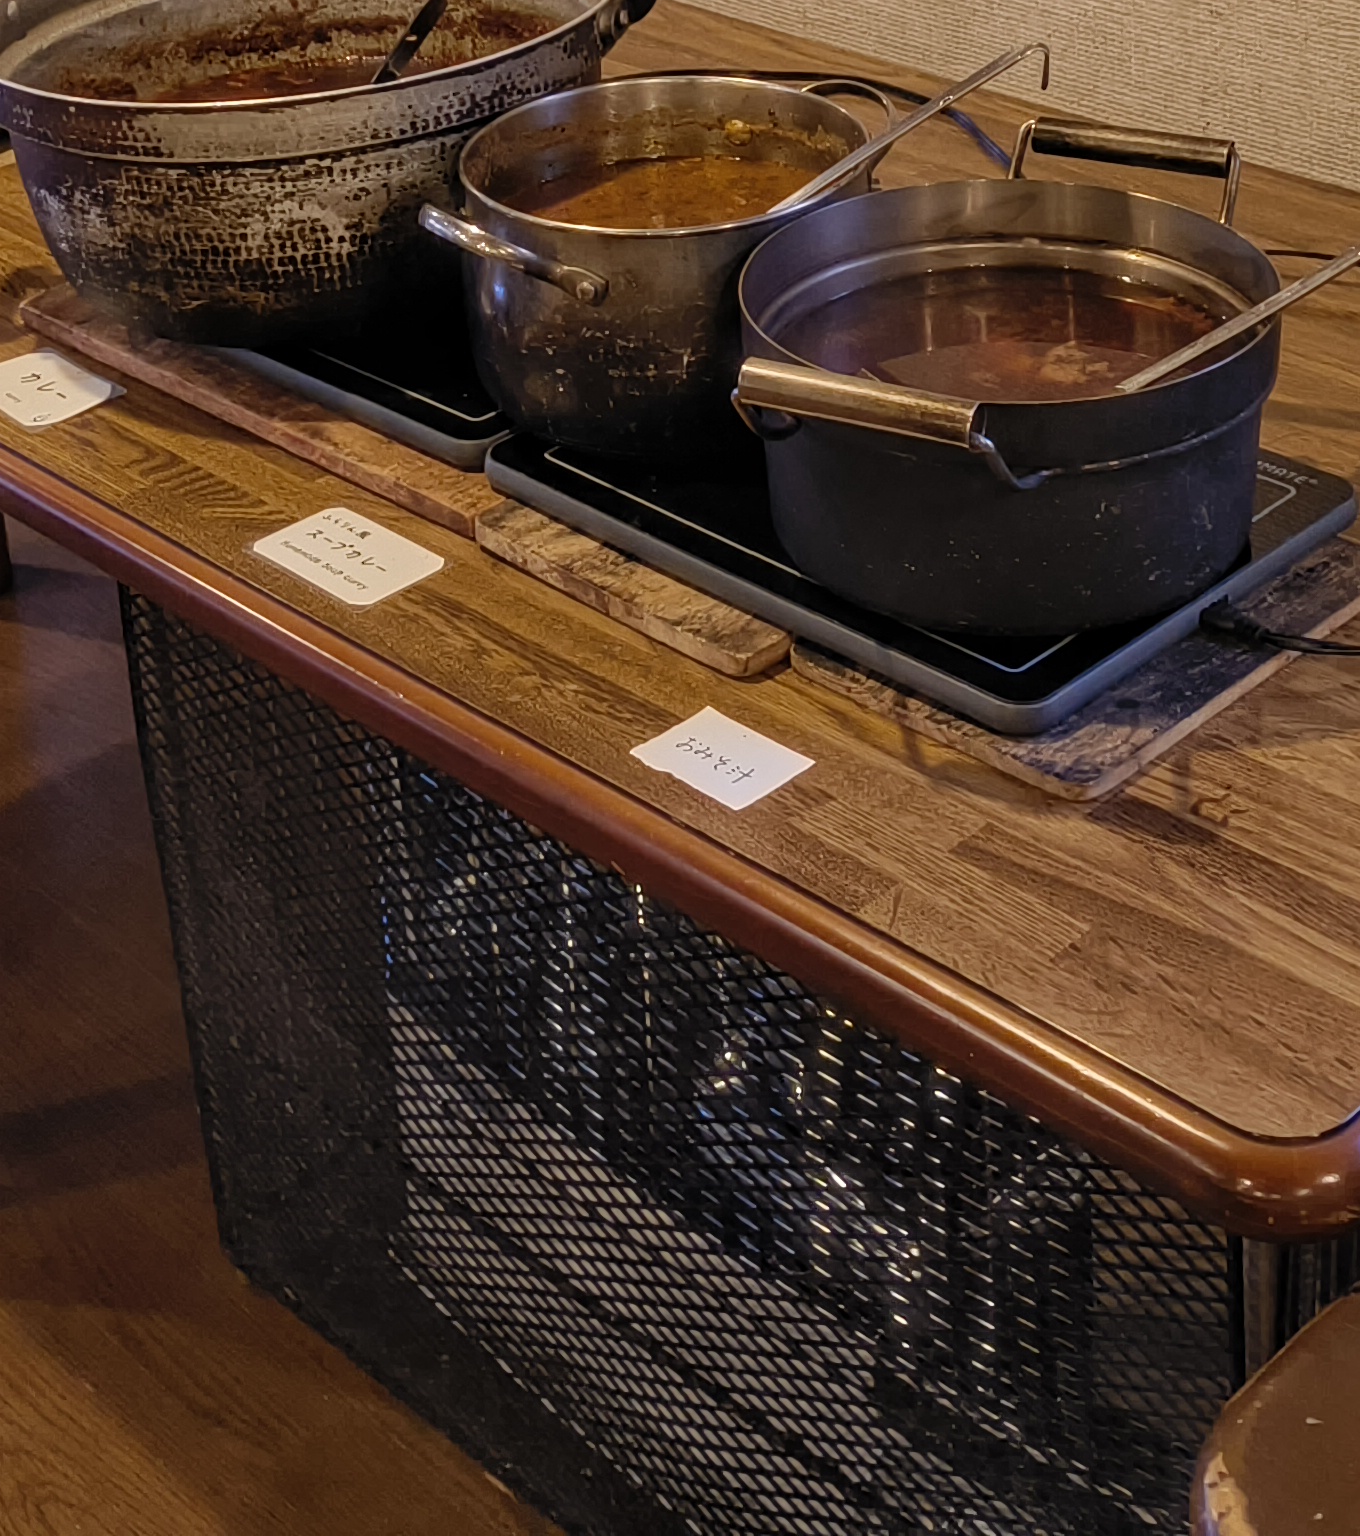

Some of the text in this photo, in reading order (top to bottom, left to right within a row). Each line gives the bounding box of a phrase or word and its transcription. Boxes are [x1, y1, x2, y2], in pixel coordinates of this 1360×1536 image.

[20, 372, 67, 399] カレー
[305, 529, 387, 572] スープカレー
[675, 736, 756, 784] おみそ汁
